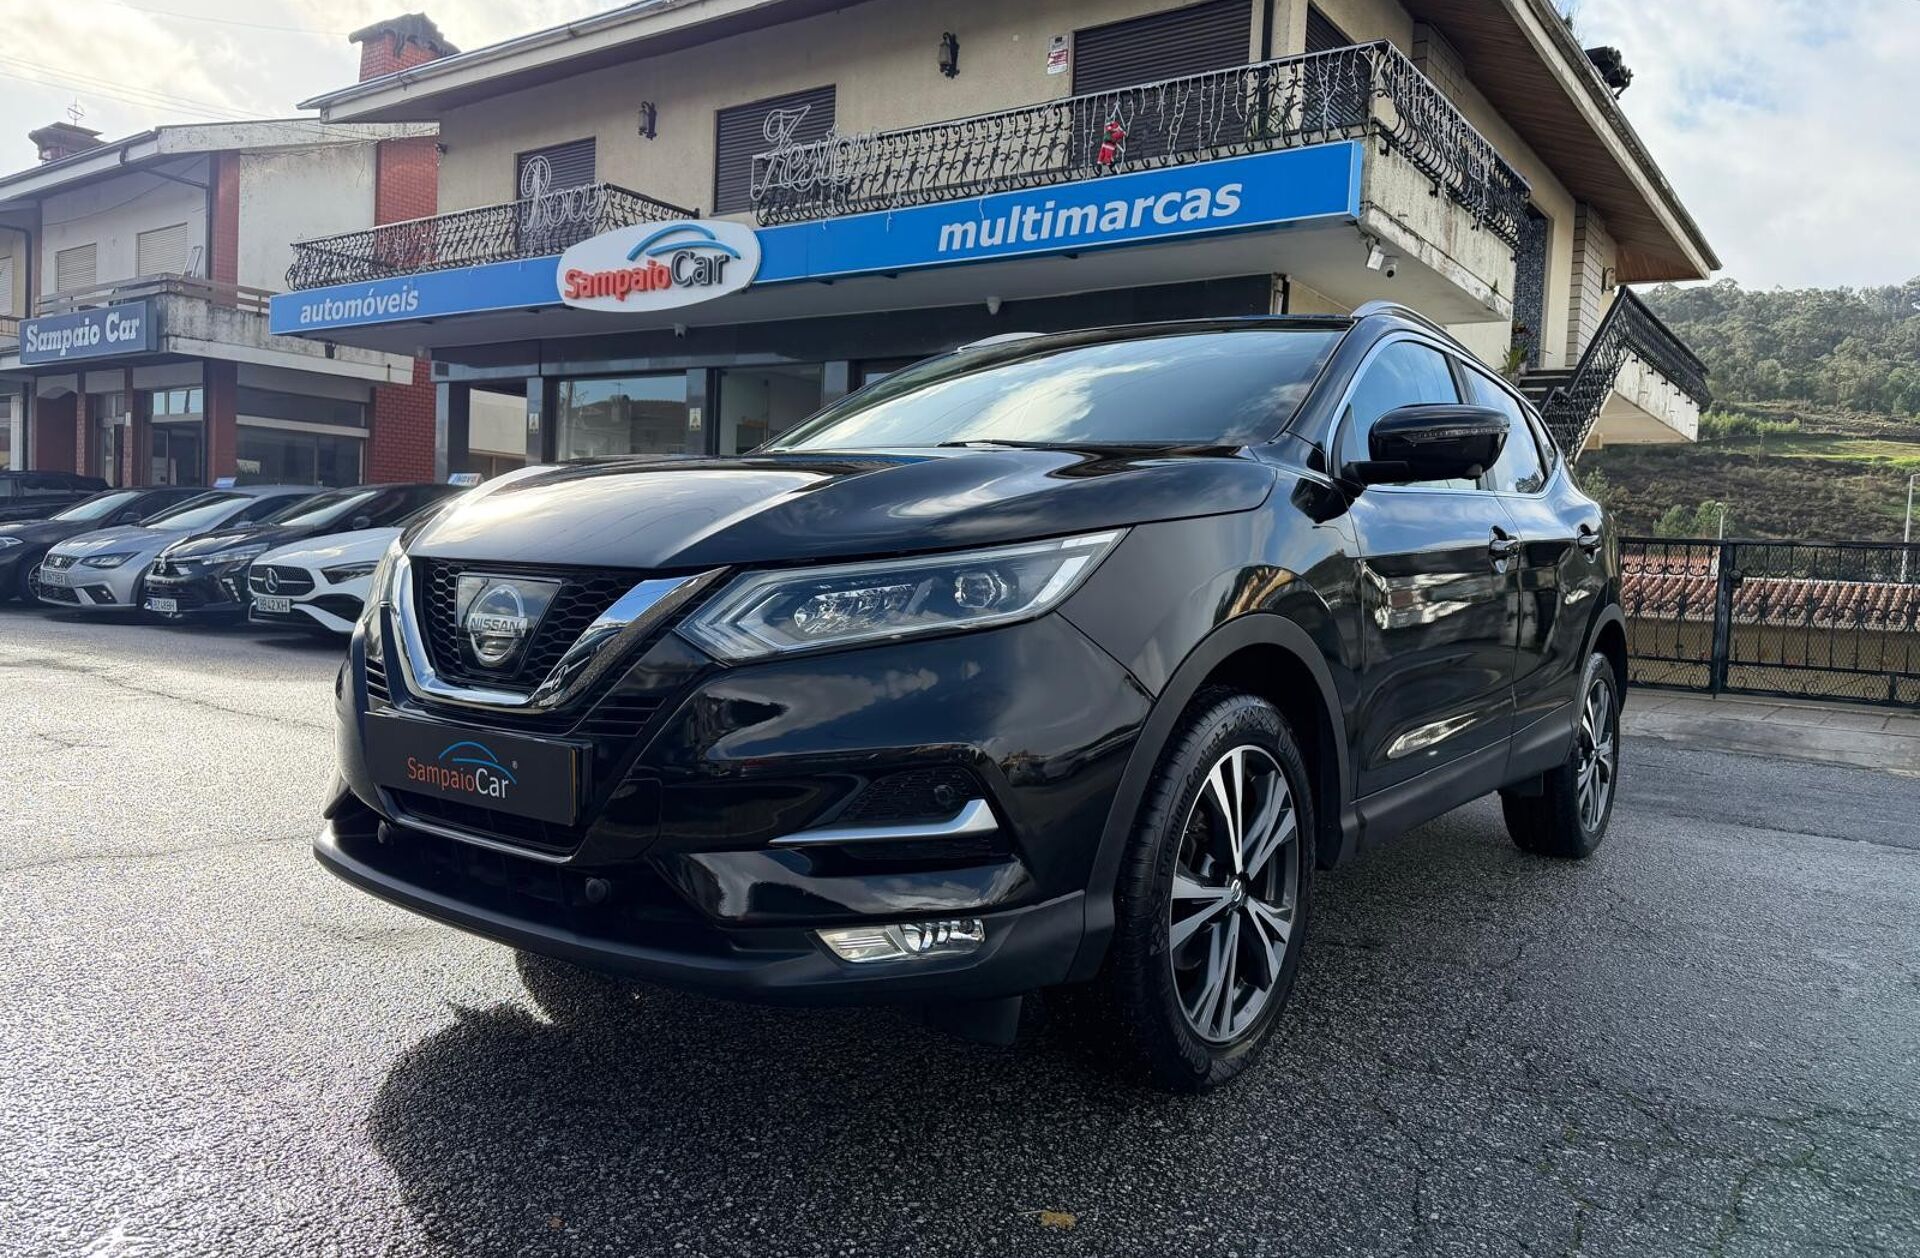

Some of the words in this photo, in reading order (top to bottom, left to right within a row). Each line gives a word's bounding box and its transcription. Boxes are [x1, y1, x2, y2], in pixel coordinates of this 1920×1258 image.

[938, 183, 1243, 251] multimarcas
[564, 250, 730, 301] SampaioCar
[300, 285, 419, 323] automóveis
[26, 317, 101, 356] Sampaio
[105, 311, 140, 343] Car
[469, 616, 523, 634] NISSAN
[407, 757, 509, 798] SampaioCar
